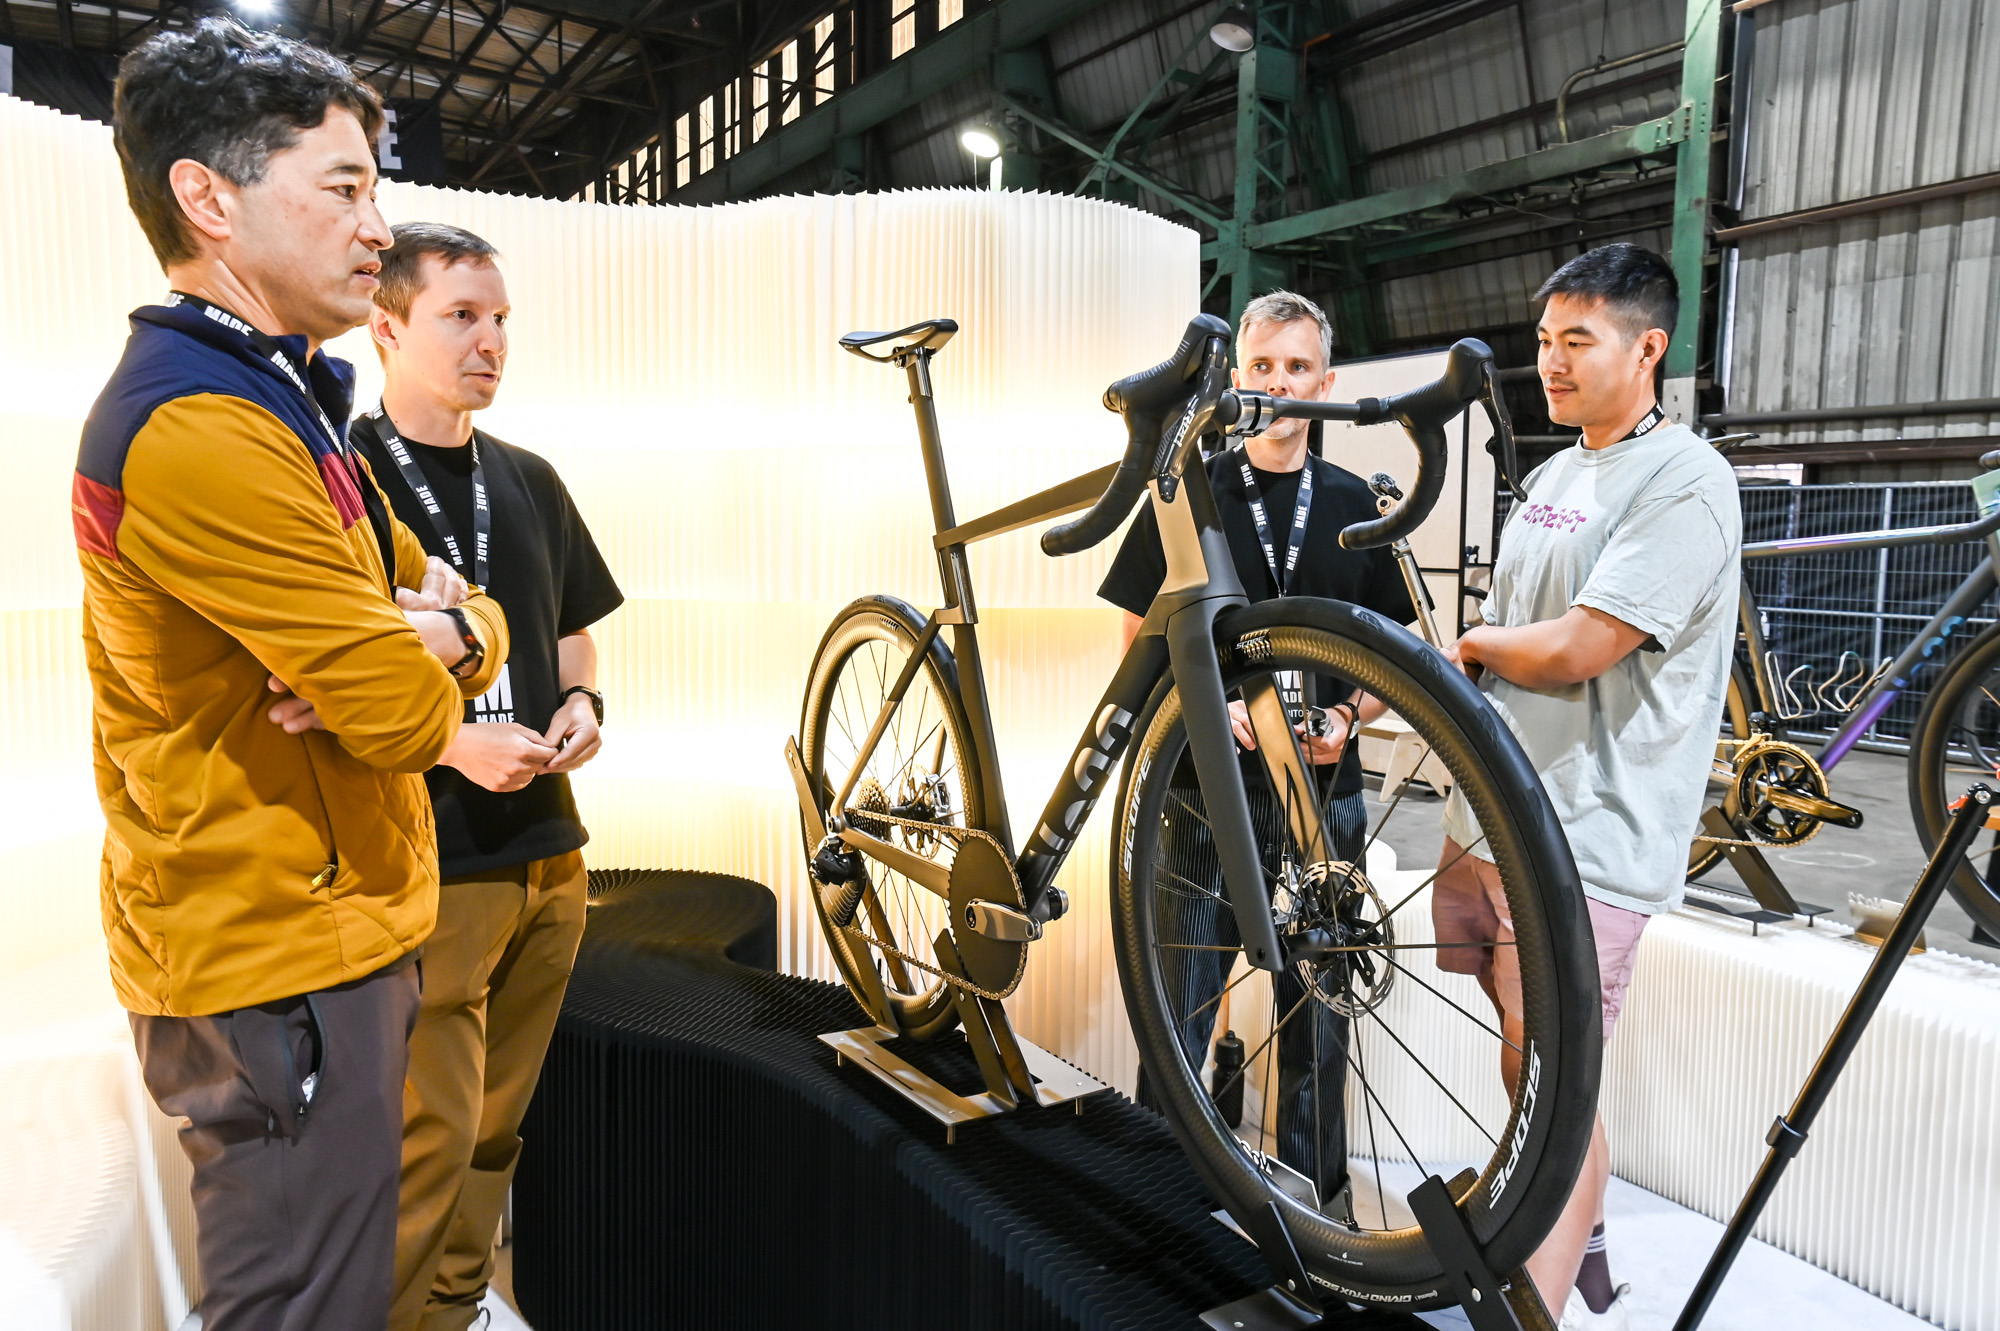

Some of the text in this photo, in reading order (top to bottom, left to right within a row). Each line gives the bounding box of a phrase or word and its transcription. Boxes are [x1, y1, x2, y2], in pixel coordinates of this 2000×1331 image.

[204, 305, 254, 336] MADE
[270, 350, 307, 394] MADE
[1634, 412, 1658, 436] MADE
[386, 435, 412, 466] MADE
[1240, 463, 1255, 487] MADE
[1301, 467, 1313, 490] MADE
[415, 484, 441, 515] MADE
[474, 482, 488, 512] MADE
[1251, 502, 1267, 527] MADE
[1294, 505, 1308, 529] MADE
[443, 535, 464, 566] MADE
[476, 531, 488, 563] MADE
[1264, 543, 1276, 568] MADE
[1286, 545, 1299, 571] MADE
[1282, 691, 1303, 703] ADE
[476, 712, 515, 723] MADE
[1124, 746, 1151, 881] SCOPE
[1489, 1039, 1541, 1209] SCOPE
[1340, 1286, 1369, 1300] PRIX
[1370, 1294, 1412, 1303] GRAND
